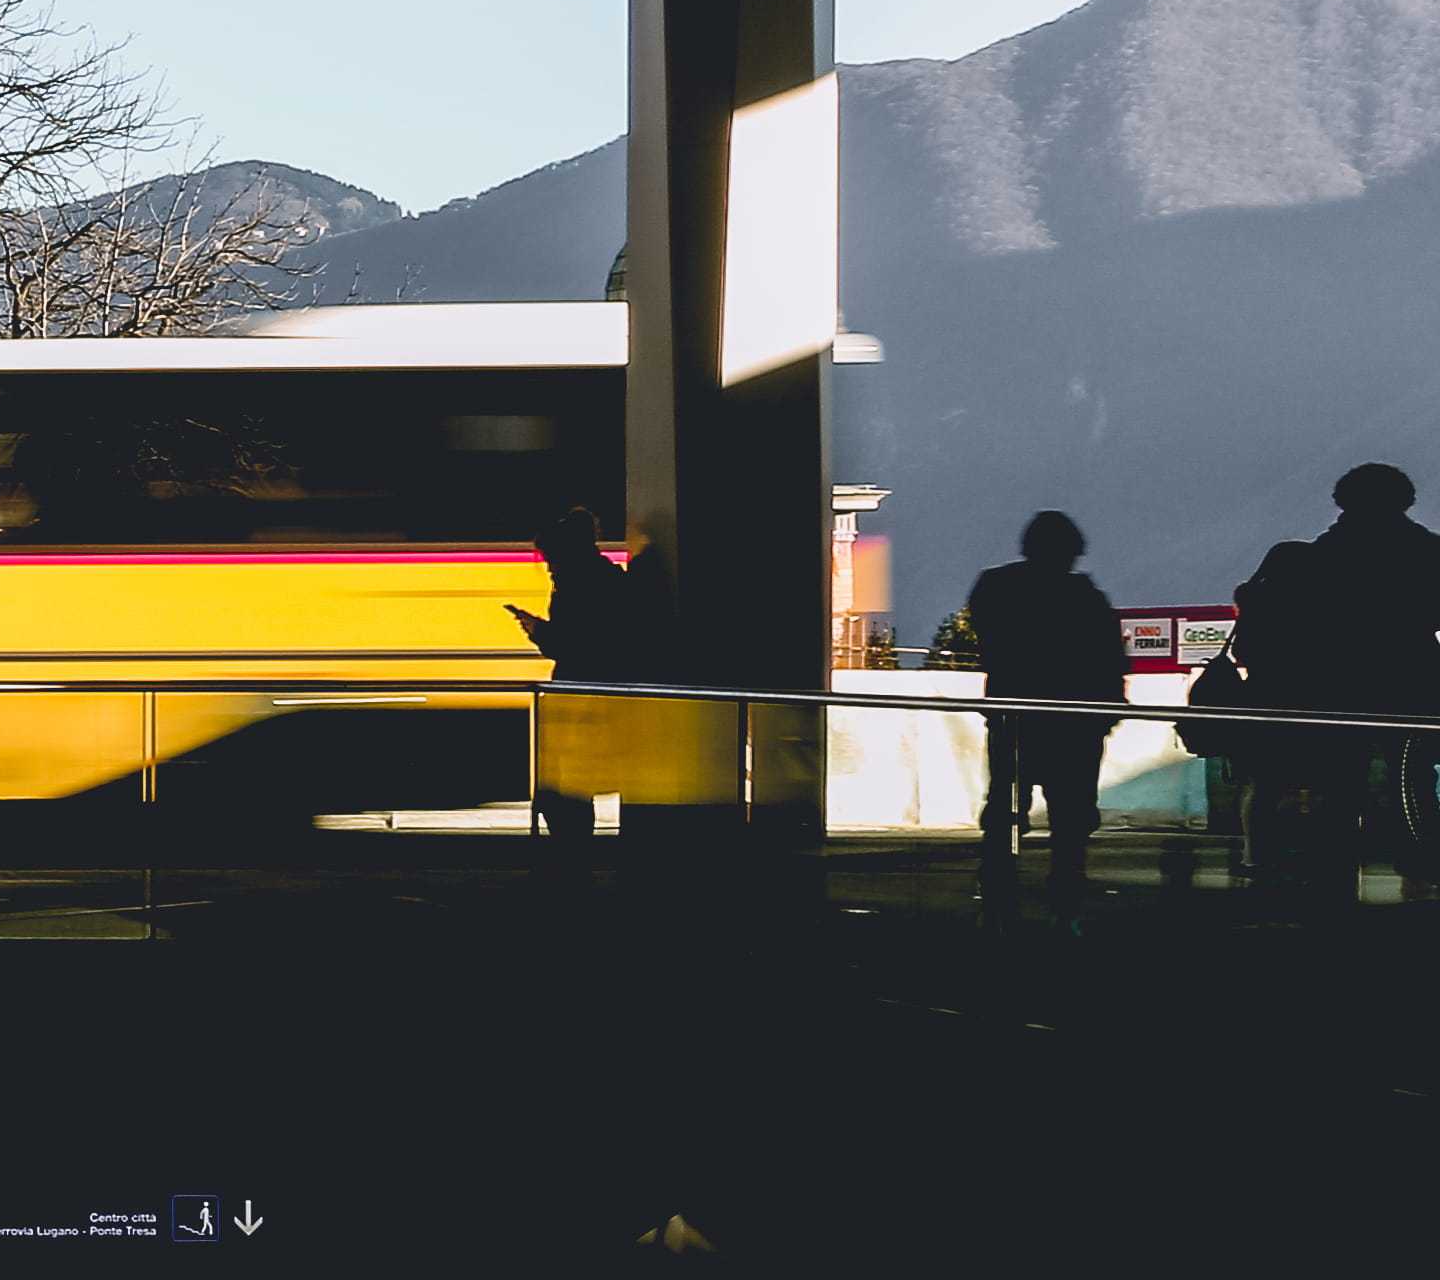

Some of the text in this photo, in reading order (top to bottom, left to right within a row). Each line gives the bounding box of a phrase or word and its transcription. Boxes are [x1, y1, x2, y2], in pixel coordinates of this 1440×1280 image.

[1134, 638, 1170, 649] FERRARI
[89, 1212, 129, 1222] Centro
[36, 1225, 79, 1238] Lugano
[89, 1225, 123, 1236] Ponte
[126, 1225, 157, 1236] Tresa
